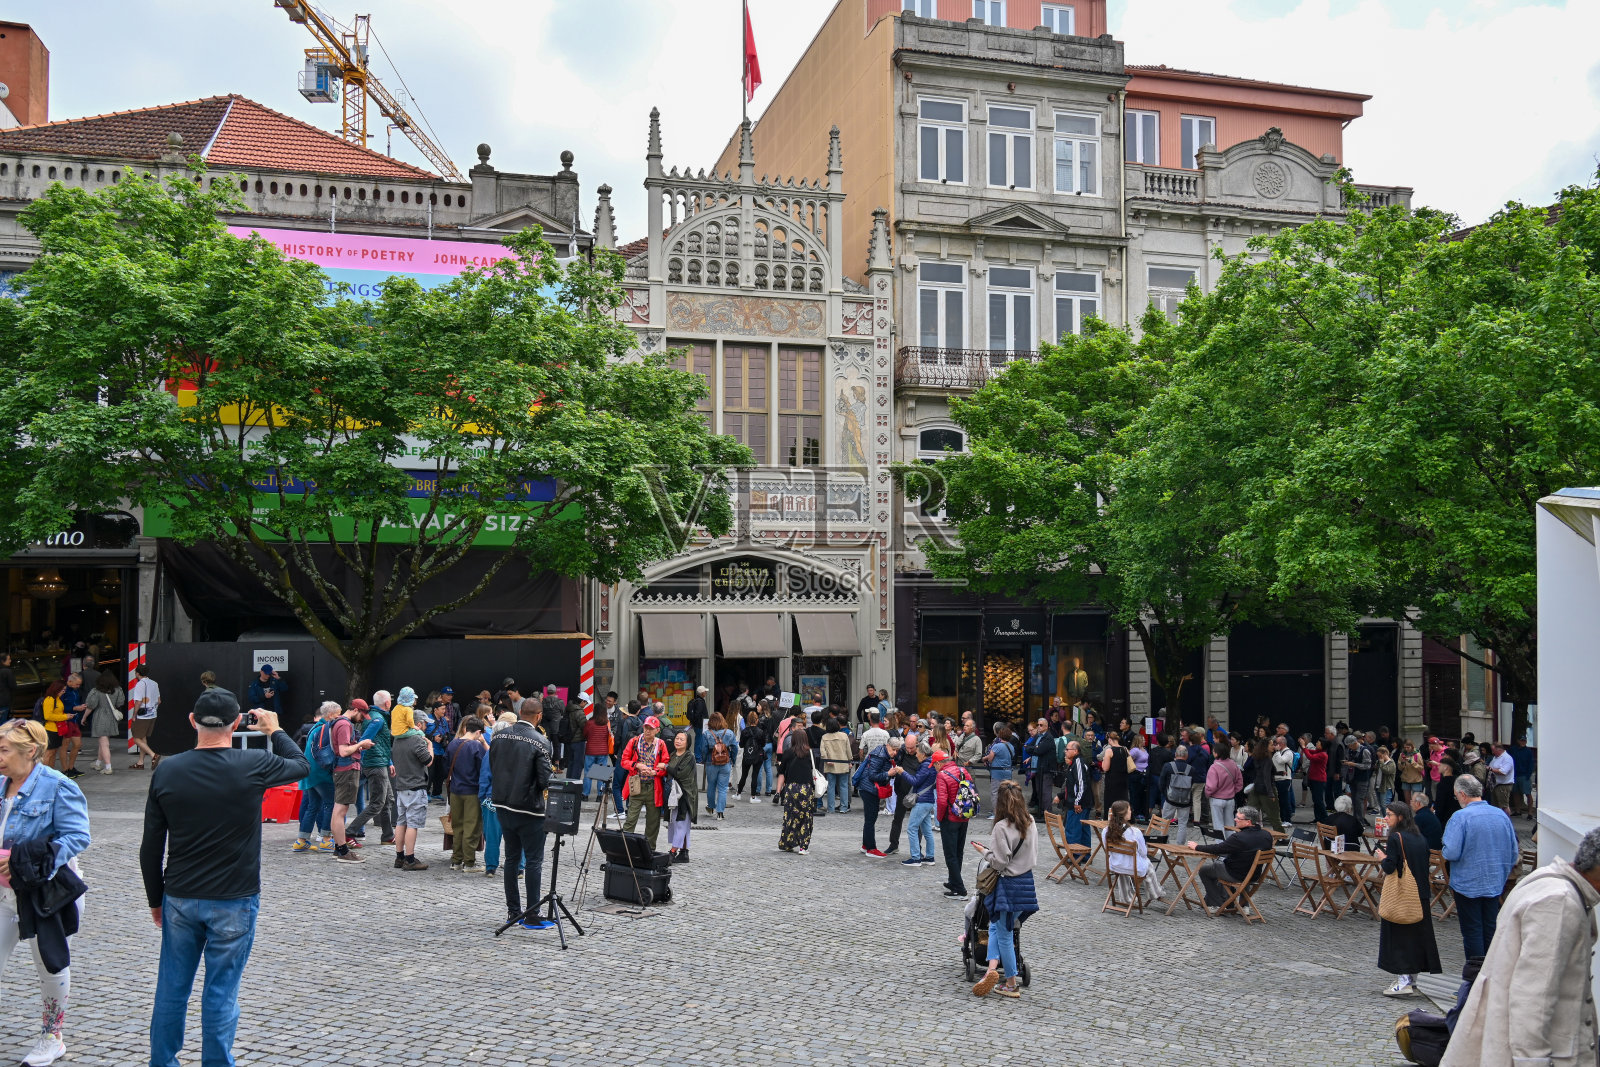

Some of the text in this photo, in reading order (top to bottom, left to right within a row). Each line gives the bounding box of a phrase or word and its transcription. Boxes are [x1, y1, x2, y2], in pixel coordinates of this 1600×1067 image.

[283, 243, 343, 257] HISTORY
[347, 249, 358, 257] OF
[361, 248, 415, 262] POETRY
[433, 253, 467, 265] JOHN
[257, 655, 285, 663] INCONS
